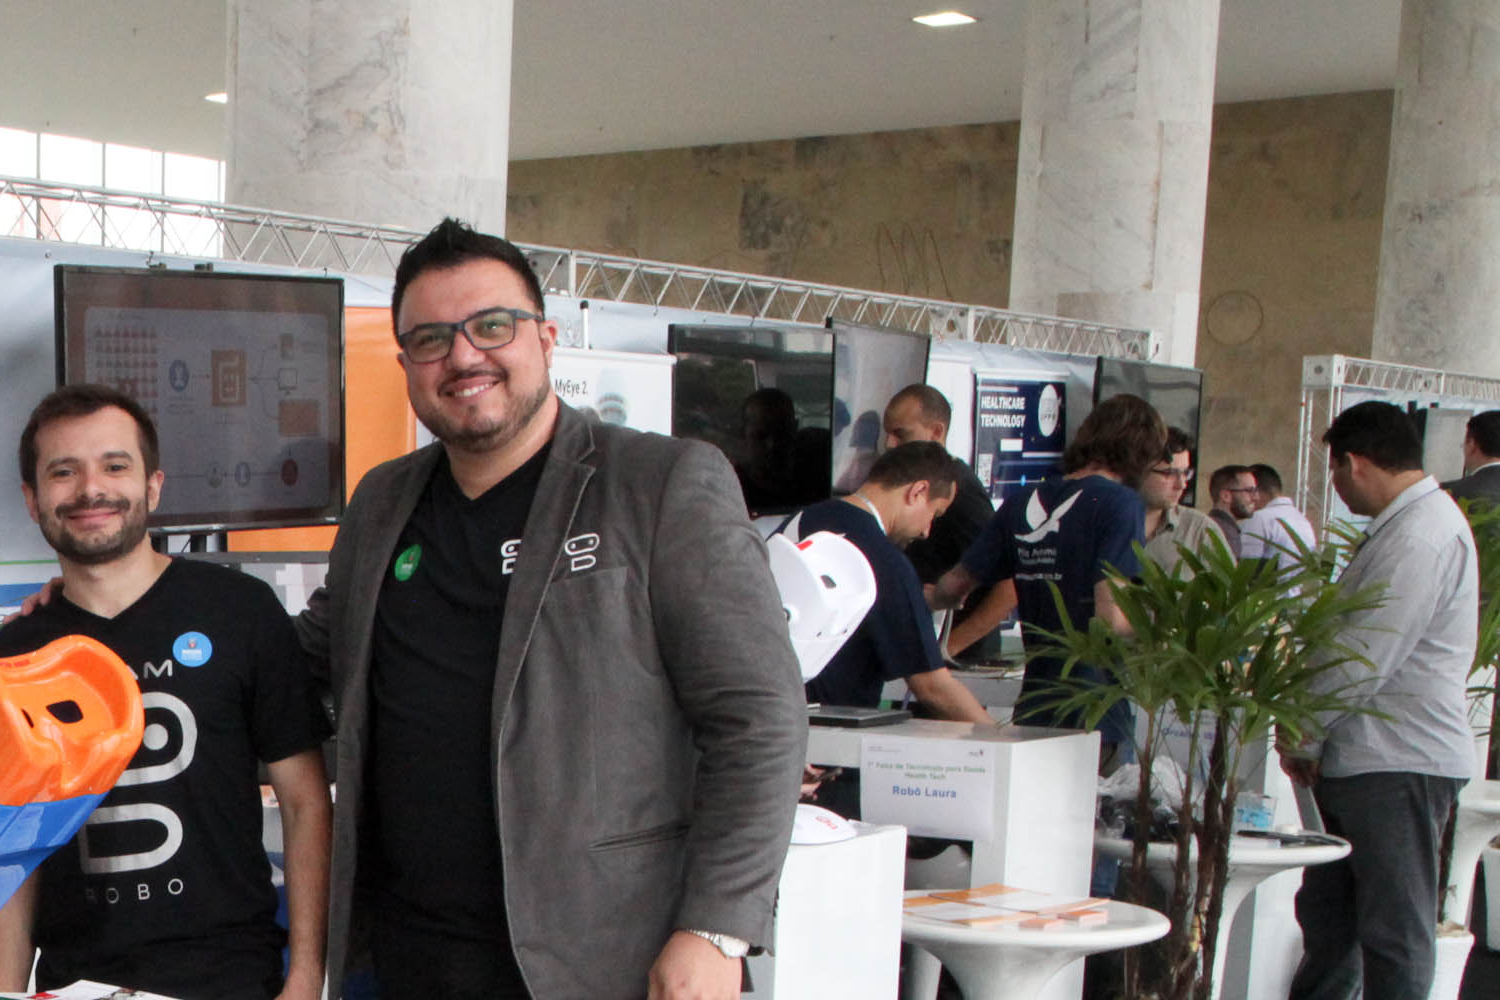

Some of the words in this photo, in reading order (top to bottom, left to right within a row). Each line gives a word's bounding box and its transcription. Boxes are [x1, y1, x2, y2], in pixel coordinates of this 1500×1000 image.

[555, 379, 580, 397] MyEye
[980, 395, 1026, 410] HEALTHCARE
[980, 414, 1026, 428] TECHNOLOGY
[892, 785, 921, 796] Robô
[925, 787, 957, 798] Laura
